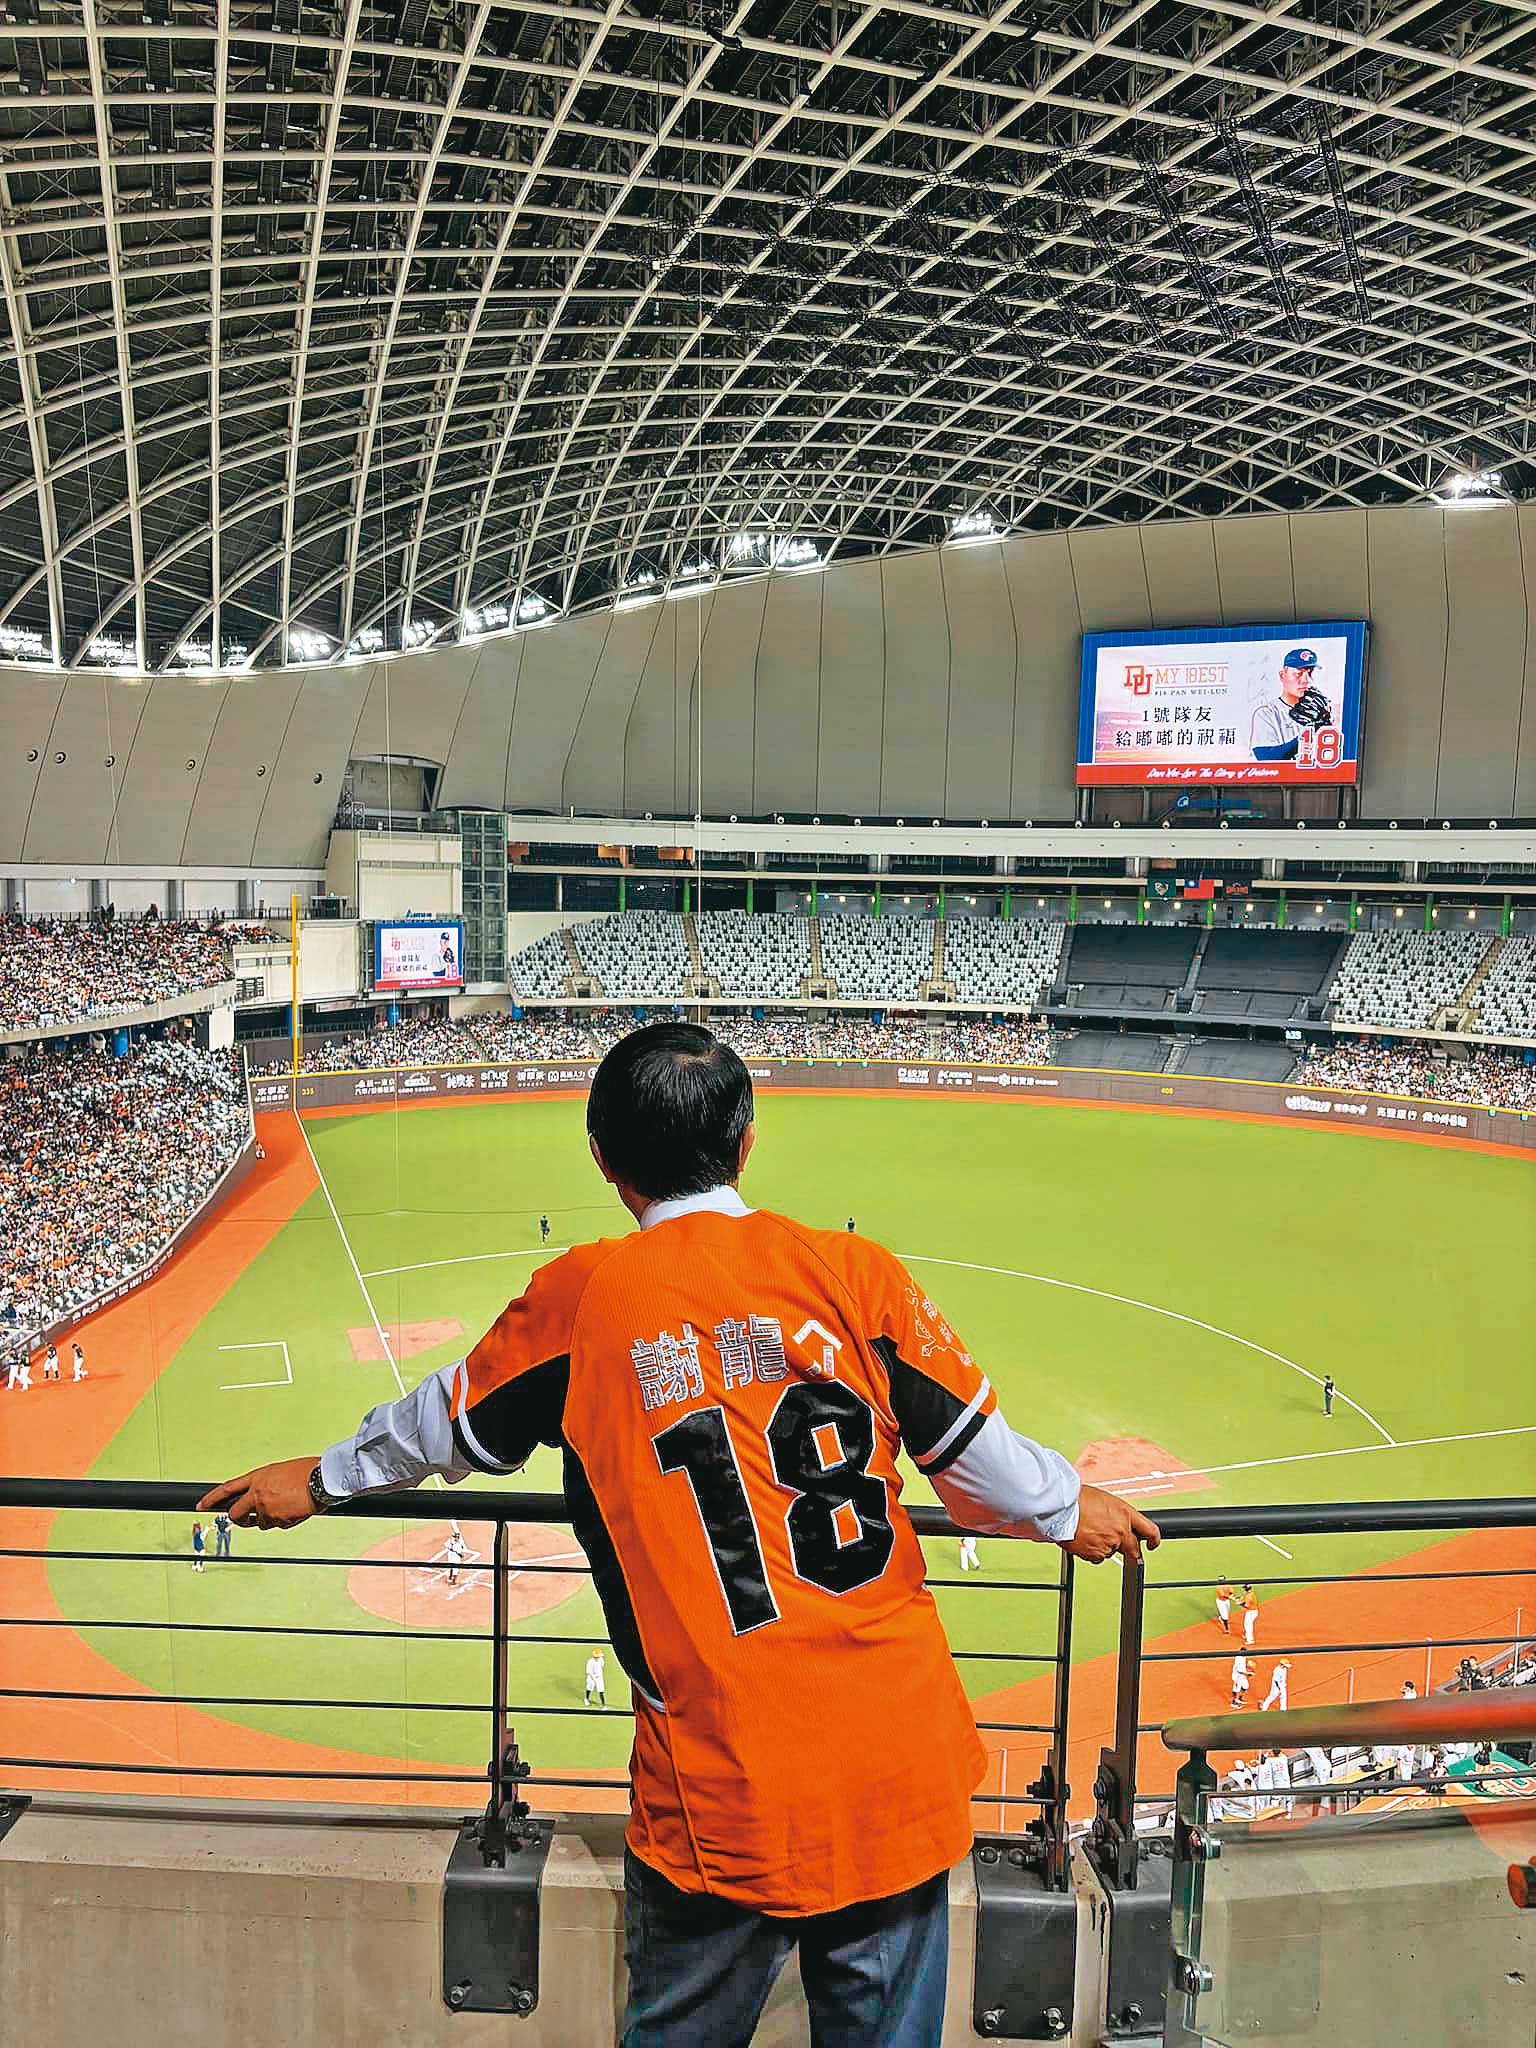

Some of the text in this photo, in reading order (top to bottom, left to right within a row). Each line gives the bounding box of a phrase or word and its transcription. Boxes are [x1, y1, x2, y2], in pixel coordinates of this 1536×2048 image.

[1155, 668, 1181, 685] MY
[1190, 688, 1228, 696] WEI-LUN
[1143, 706, 1212, 723] 1號隊友
[1115, 728, 1236, 747] 給嘟嘟的祝福
[1298, 728, 1342, 766] 18
[480, 1070, 510, 1081] snug
[629, 1313, 844, 1411] 謝龍介
[651, 1379, 896, 1637] 18
